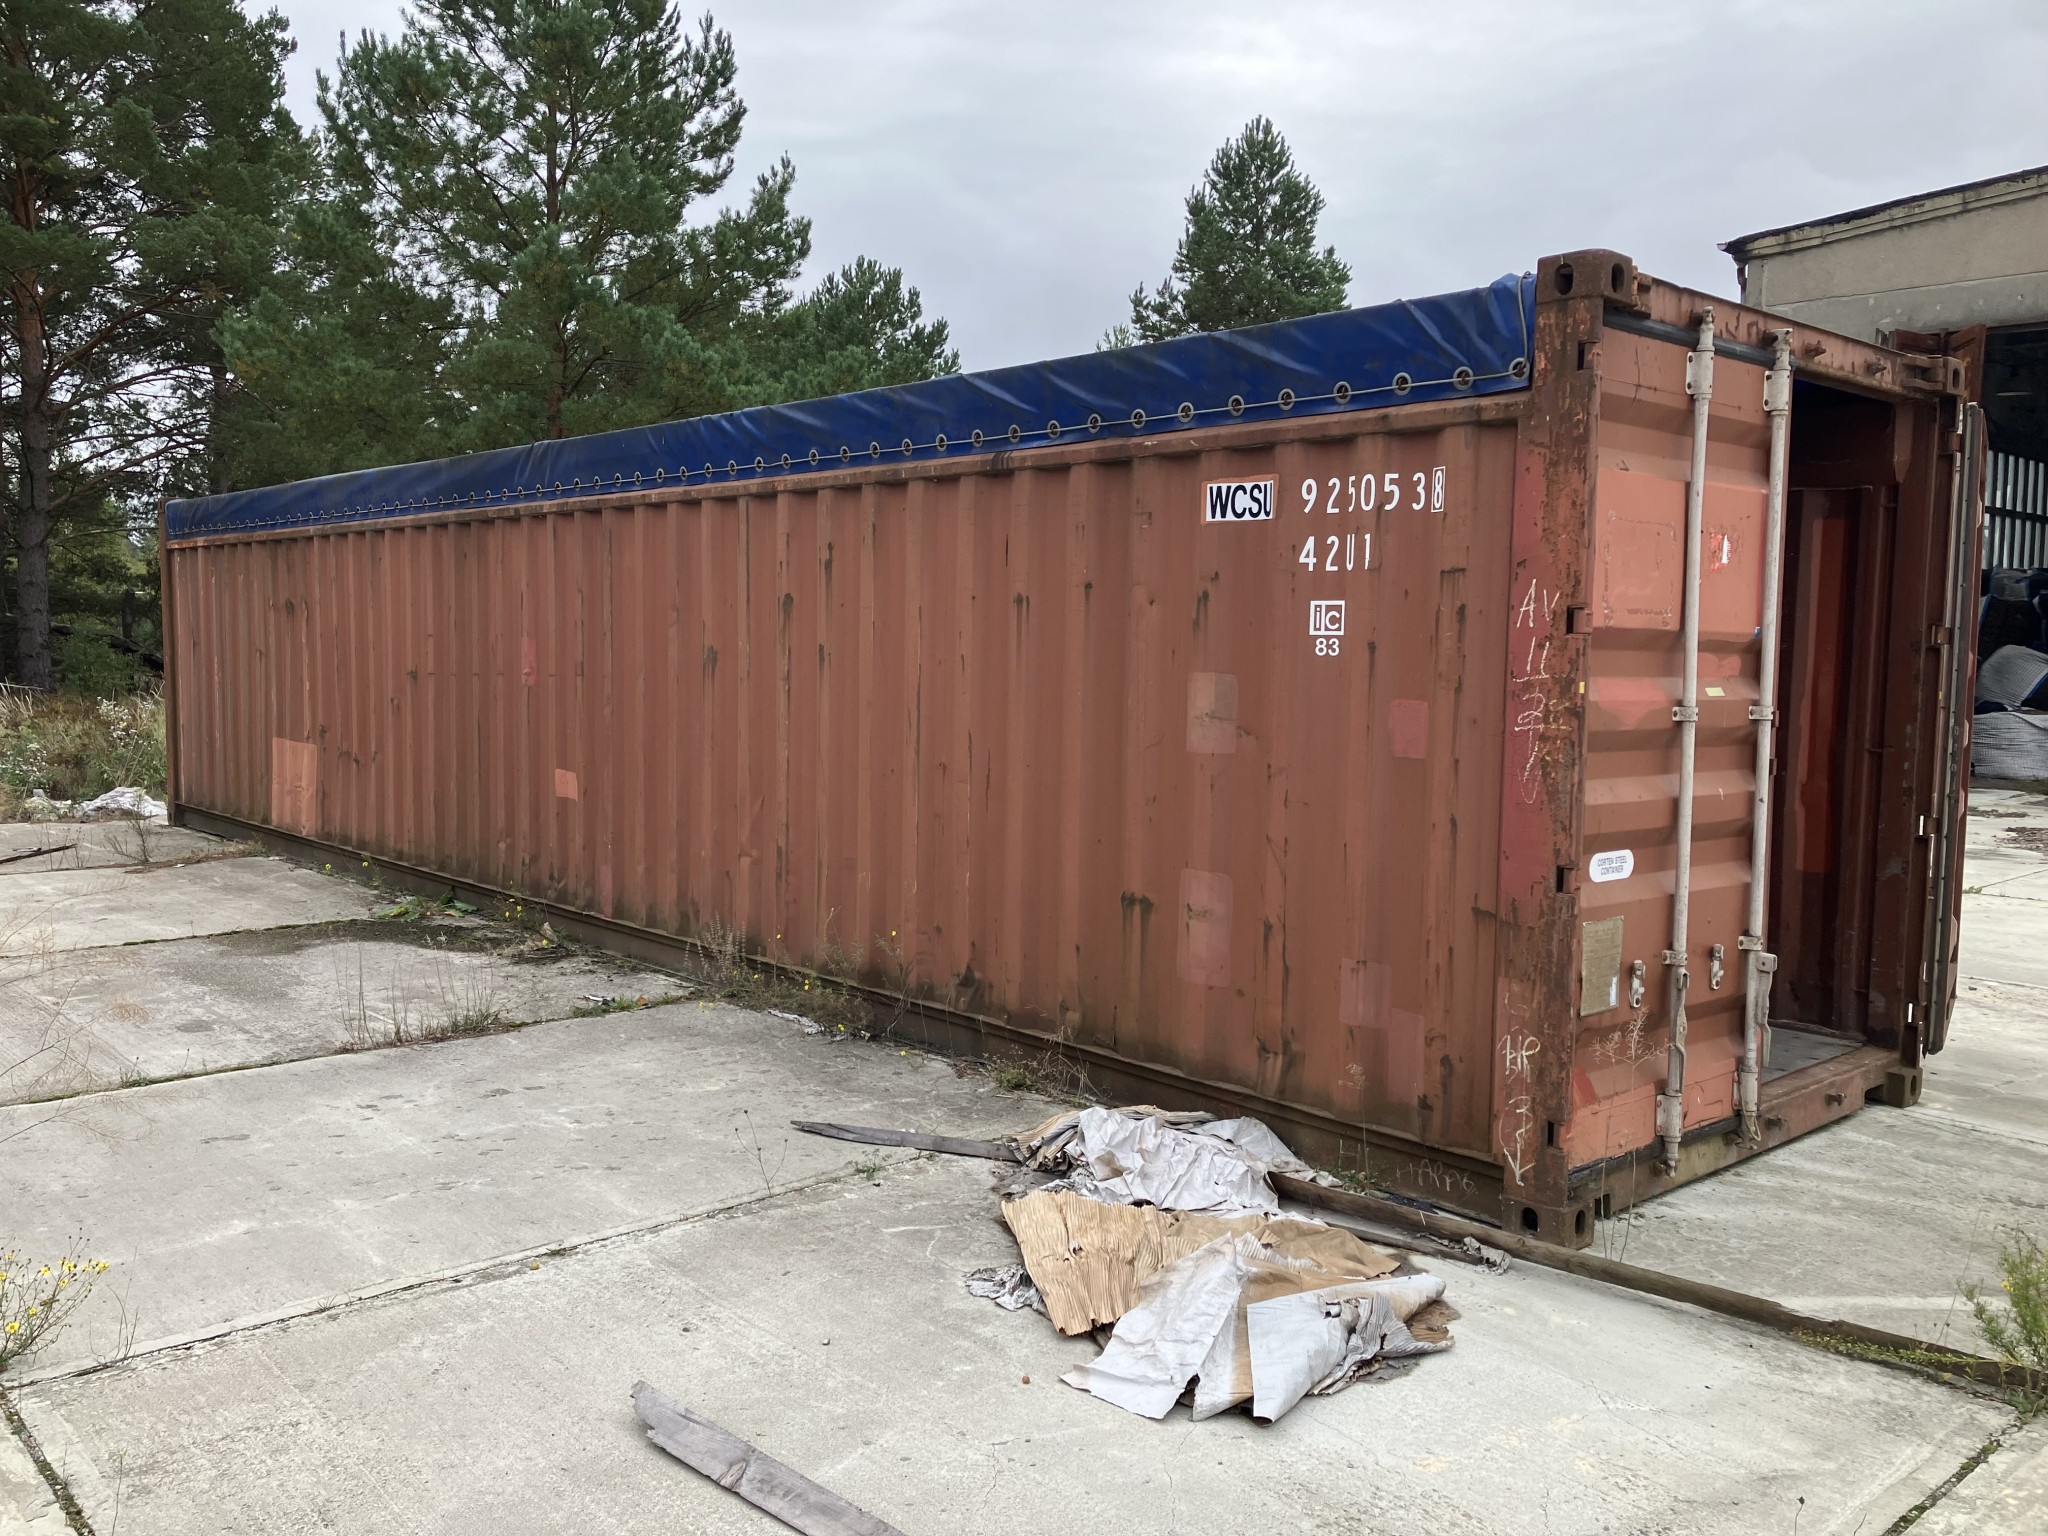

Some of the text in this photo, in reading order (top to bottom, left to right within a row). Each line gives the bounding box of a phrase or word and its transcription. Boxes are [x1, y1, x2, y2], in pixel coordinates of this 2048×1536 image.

[1208, 482, 1274, 520] WCSU
[1298, 533, 1371, 572] 42U1
[1314, 637, 1341, 657] 83
